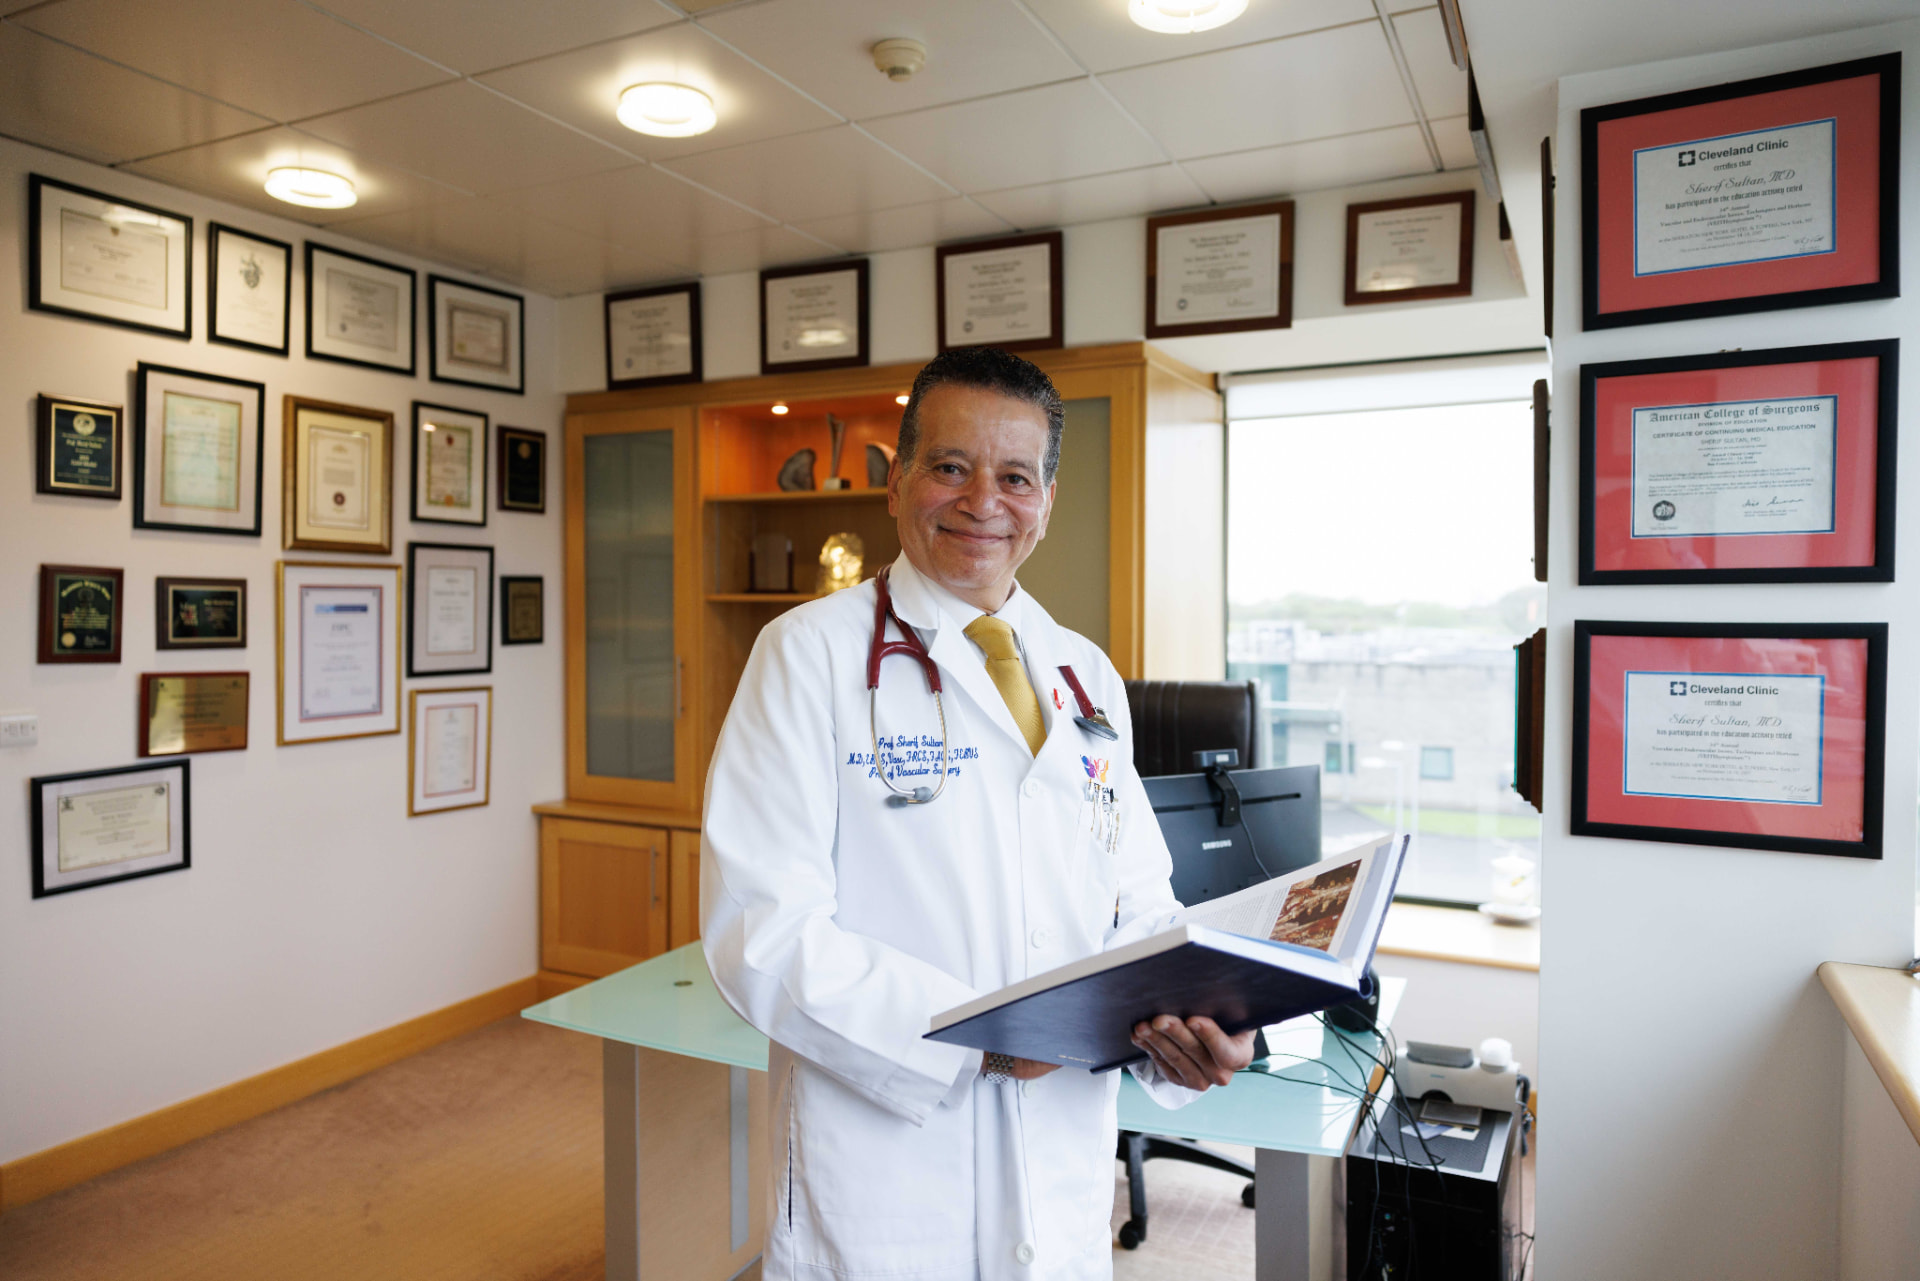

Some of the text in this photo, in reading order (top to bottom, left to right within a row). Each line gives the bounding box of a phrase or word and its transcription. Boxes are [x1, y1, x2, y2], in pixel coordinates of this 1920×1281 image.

[1699, 139, 1789, 162] Cleveland Clinic
[1714, 160, 1752, 172] certifies that
[1685, 168, 1796, 195] Sherif Sultan, MD
[1665, 202, 1676, 210] has
[1677, 197, 1712, 210] participated
[1731, 190, 1760, 200] education
[1650, 403, 1820, 423] American College of Surgeons
[1652, 431, 1693, 439] CERTIFICATE
[1705, 428, 1744, 436] CONTINUING
[1746, 425, 1774, 433] MEDICAL
[1777, 424, 1816, 432] EDUCATION
[1690, 684, 1779, 695] Cleveland Clinic
[1669, 714, 1782, 727] Sherif Sultan, MD
[878, 735, 943, 750] Prof Sherif Sultan
[887, 766, 894, 780] of
[896, 764, 930, 777] Vascular
